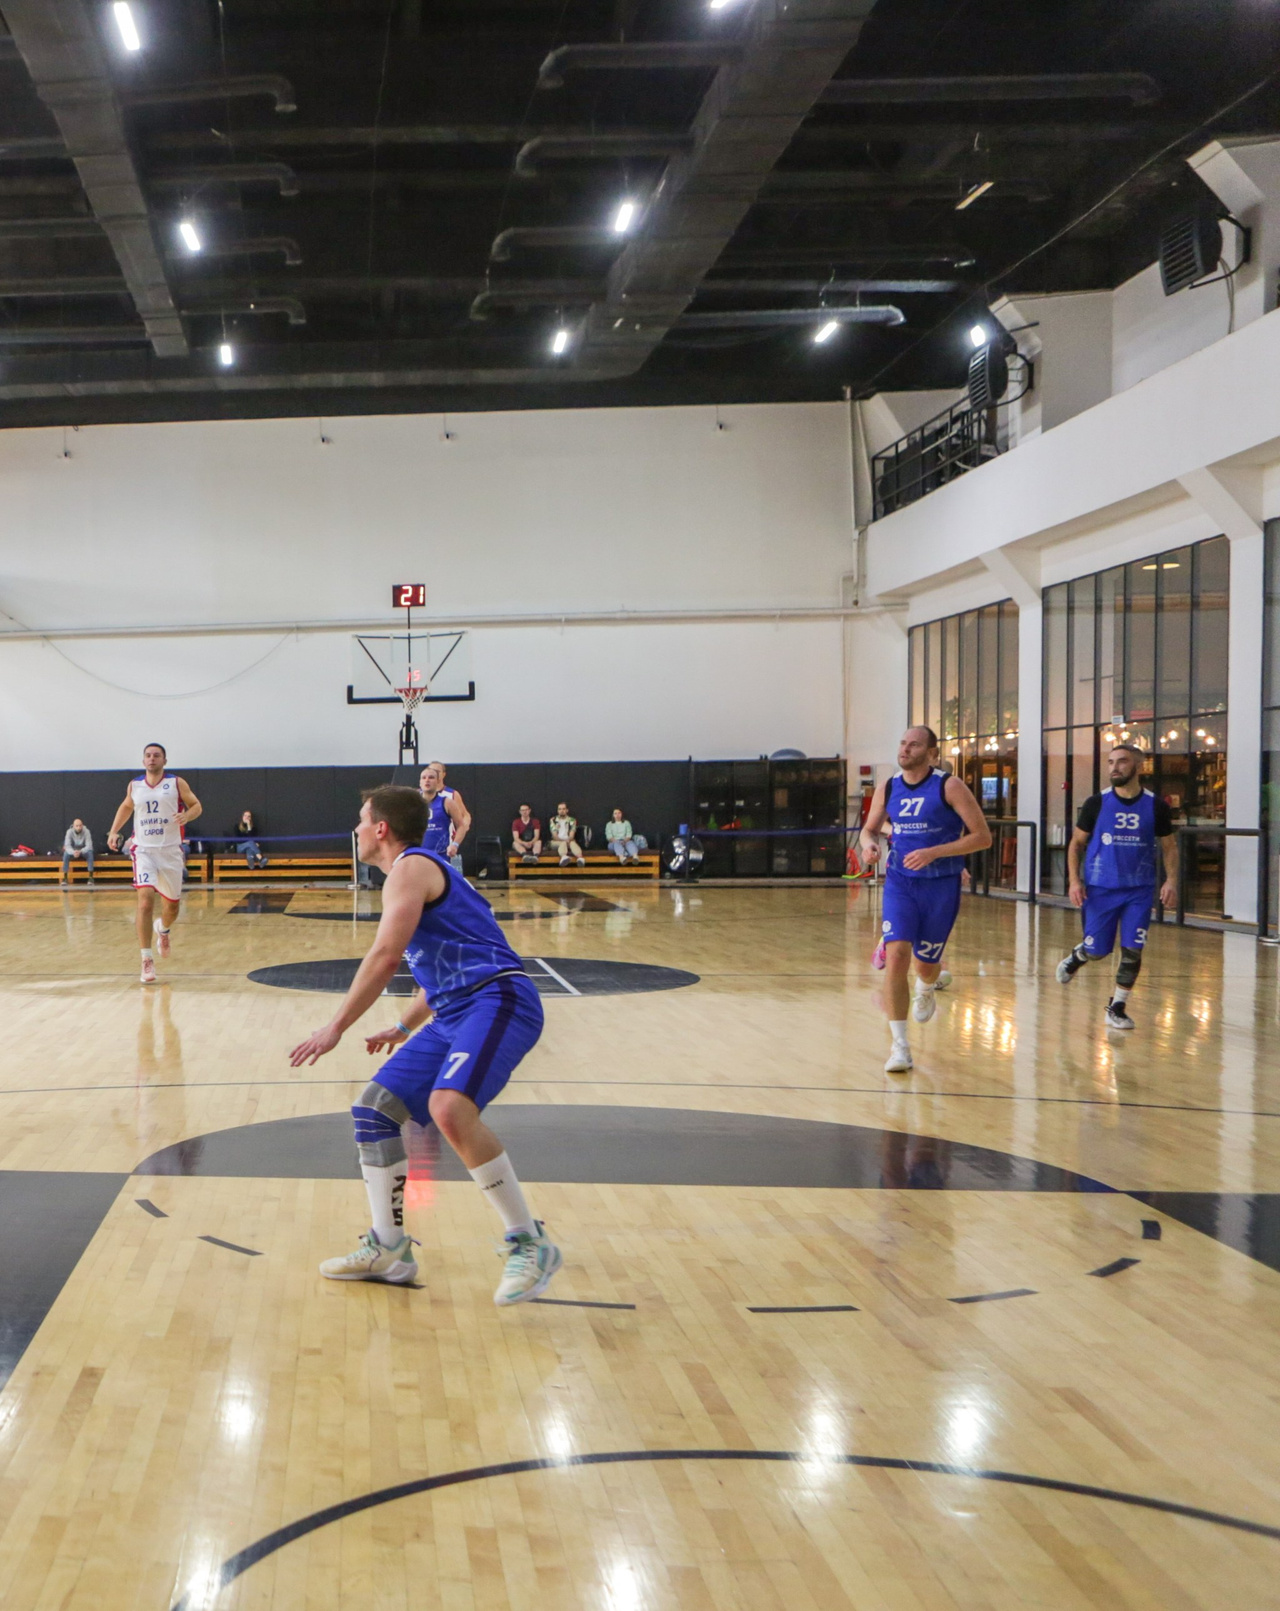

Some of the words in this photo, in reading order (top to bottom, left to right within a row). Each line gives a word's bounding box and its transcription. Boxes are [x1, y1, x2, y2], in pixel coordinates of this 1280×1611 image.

[400, 585, 425, 606] 21
[146, 800, 159, 814] 12
[898, 797, 925, 817] 27
[1114, 812, 1140, 830] 33
[144, 828, 165, 837] САРОВ
[138, 872, 149, 884] 12
[917, 940, 945, 960] 27
[442, 1052, 471, 1080] 7
